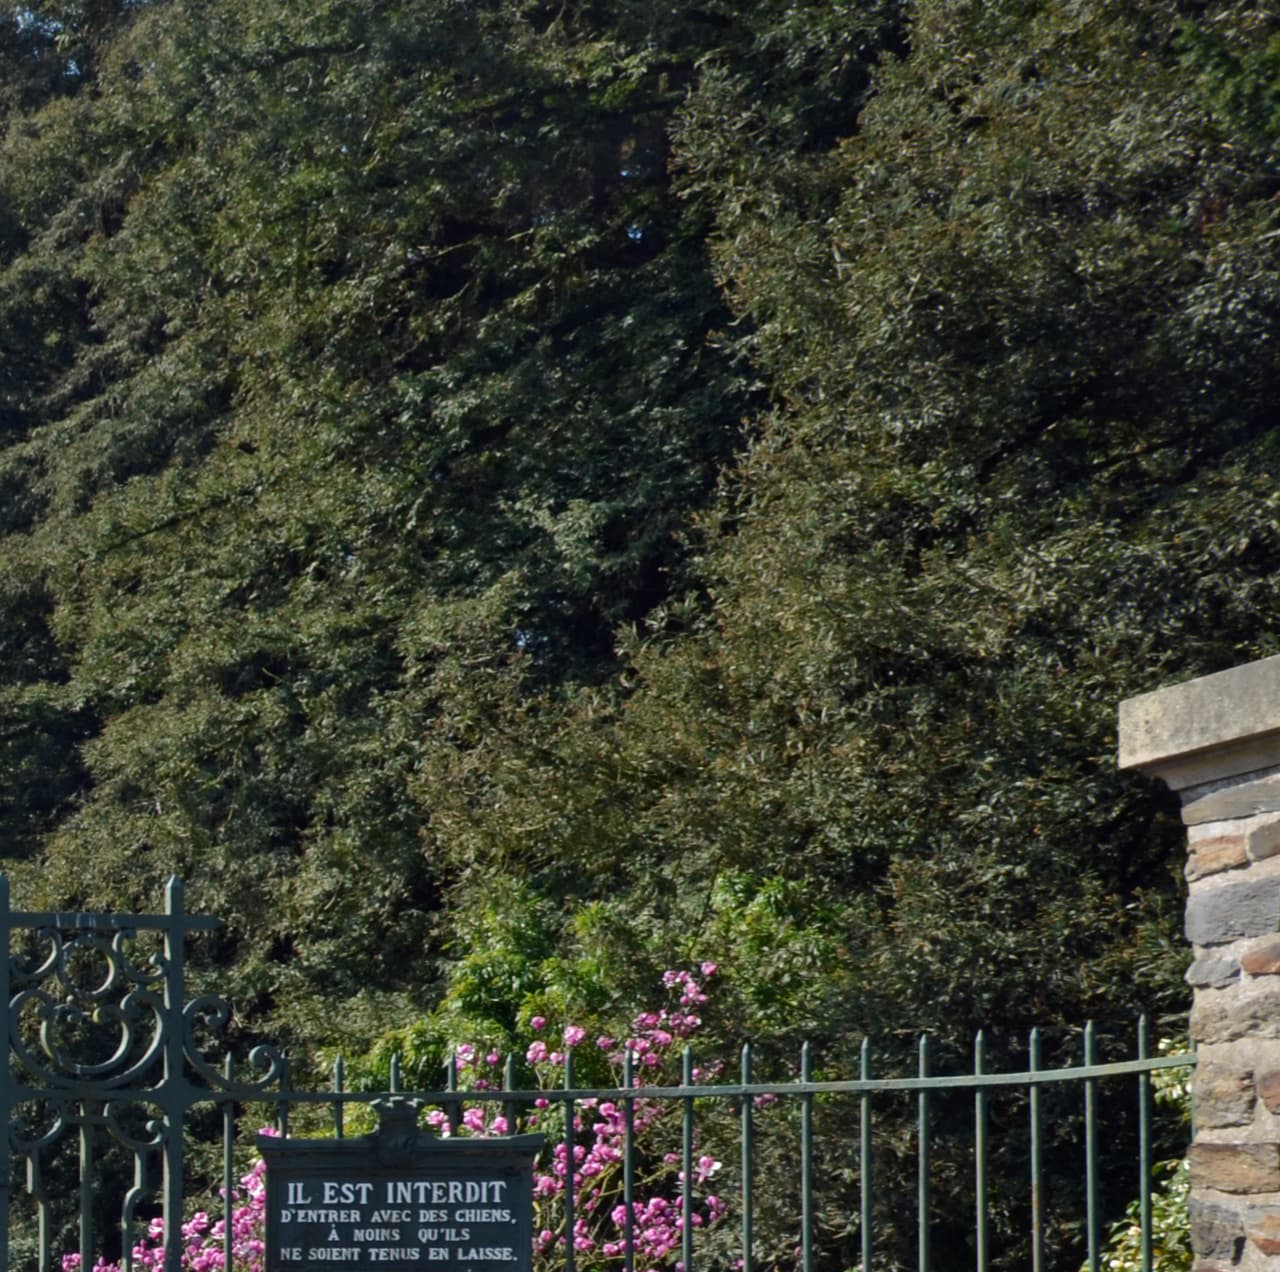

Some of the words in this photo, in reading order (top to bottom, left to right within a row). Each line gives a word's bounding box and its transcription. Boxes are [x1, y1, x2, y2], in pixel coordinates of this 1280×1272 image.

[287, 1182, 311, 1204] IL
[323, 1182, 373, 1204] EST
[387, 1181, 508, 1204] INTERDIT
[280, 1208, 361, 1223] D'ENTRER
[371, 1209, 412, 1223] AVEC
[418, 1209, 449, 1223] DES
[353, 1228, 400, 1242] MOINS
[417, 1228, 471, 1244] QU'ILS
[280, 1247, 303, 1261] NE
[308, 1247, 362, 1261] SOIENT
[368, 1248, 420, 1261] TENUS
[428, 1247, 450, 1260] EN
[456, 1247, 518, 1261] LAISSE.
